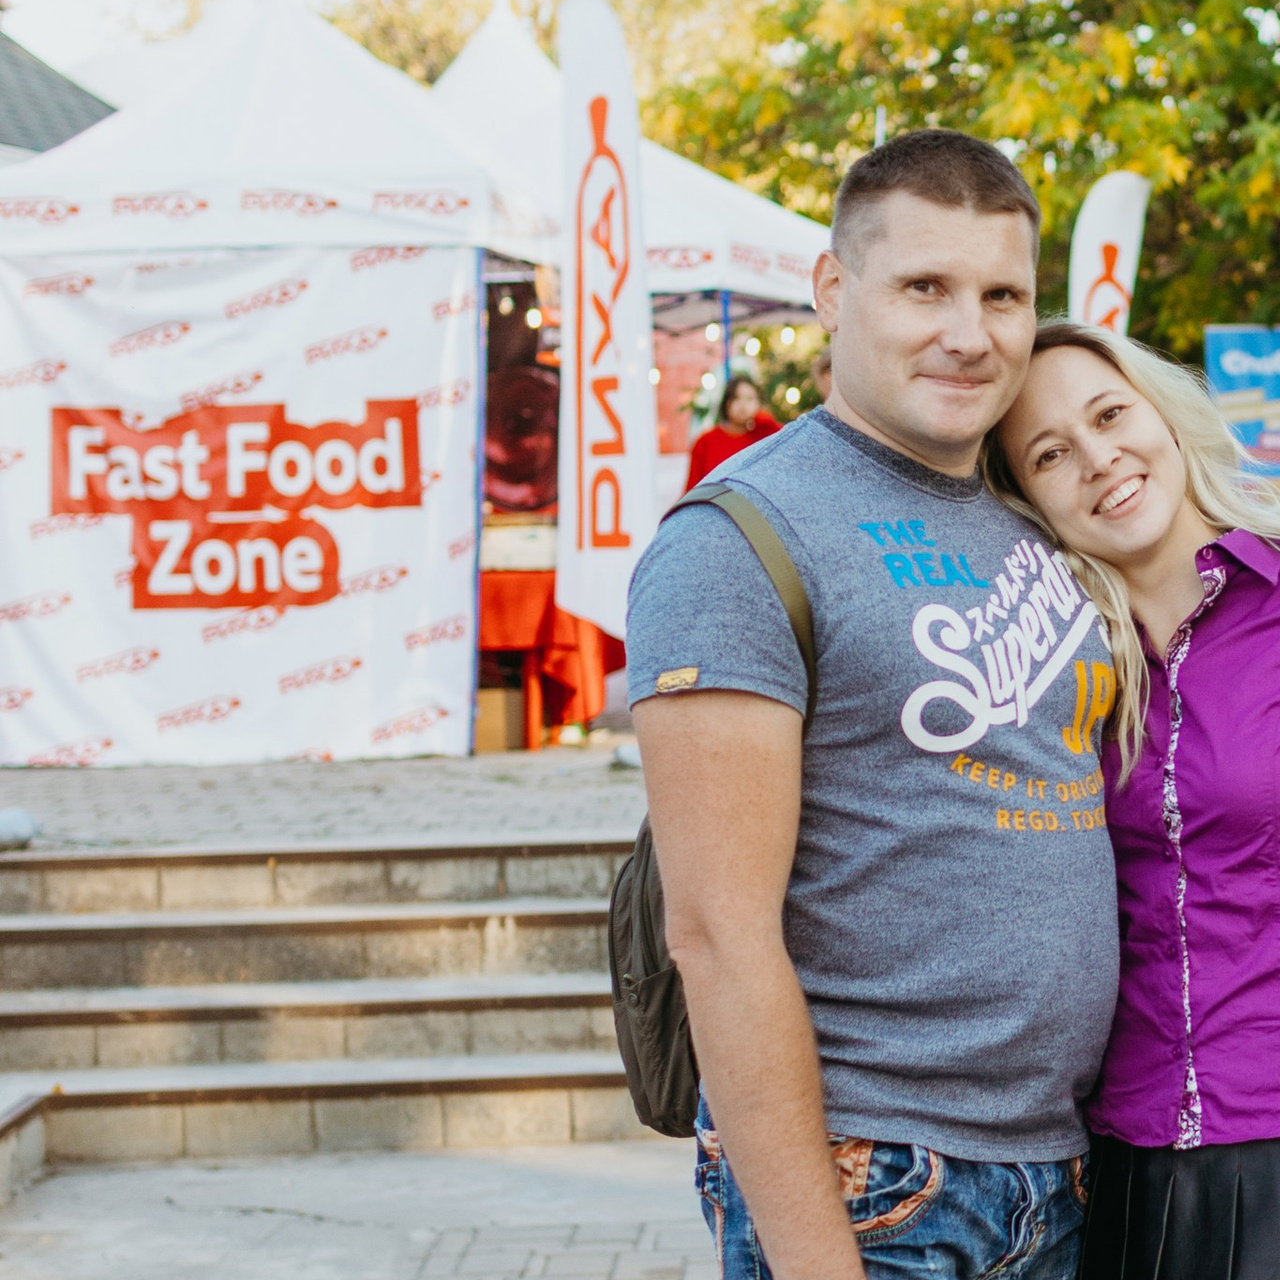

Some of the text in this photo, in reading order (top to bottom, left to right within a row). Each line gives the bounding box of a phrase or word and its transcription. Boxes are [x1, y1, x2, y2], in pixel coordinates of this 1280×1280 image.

[67, 417, 403, 501] Fast Food
[147, 520, 324, 596] Zone
[859, 520, 936, 548] THE
[883, 552, 990, 590] REAL
[901, 540, 1099, 753] Superdr
[950, 753, 1017, 792] KEEP
[1026, 777, 1048, 801] IT
